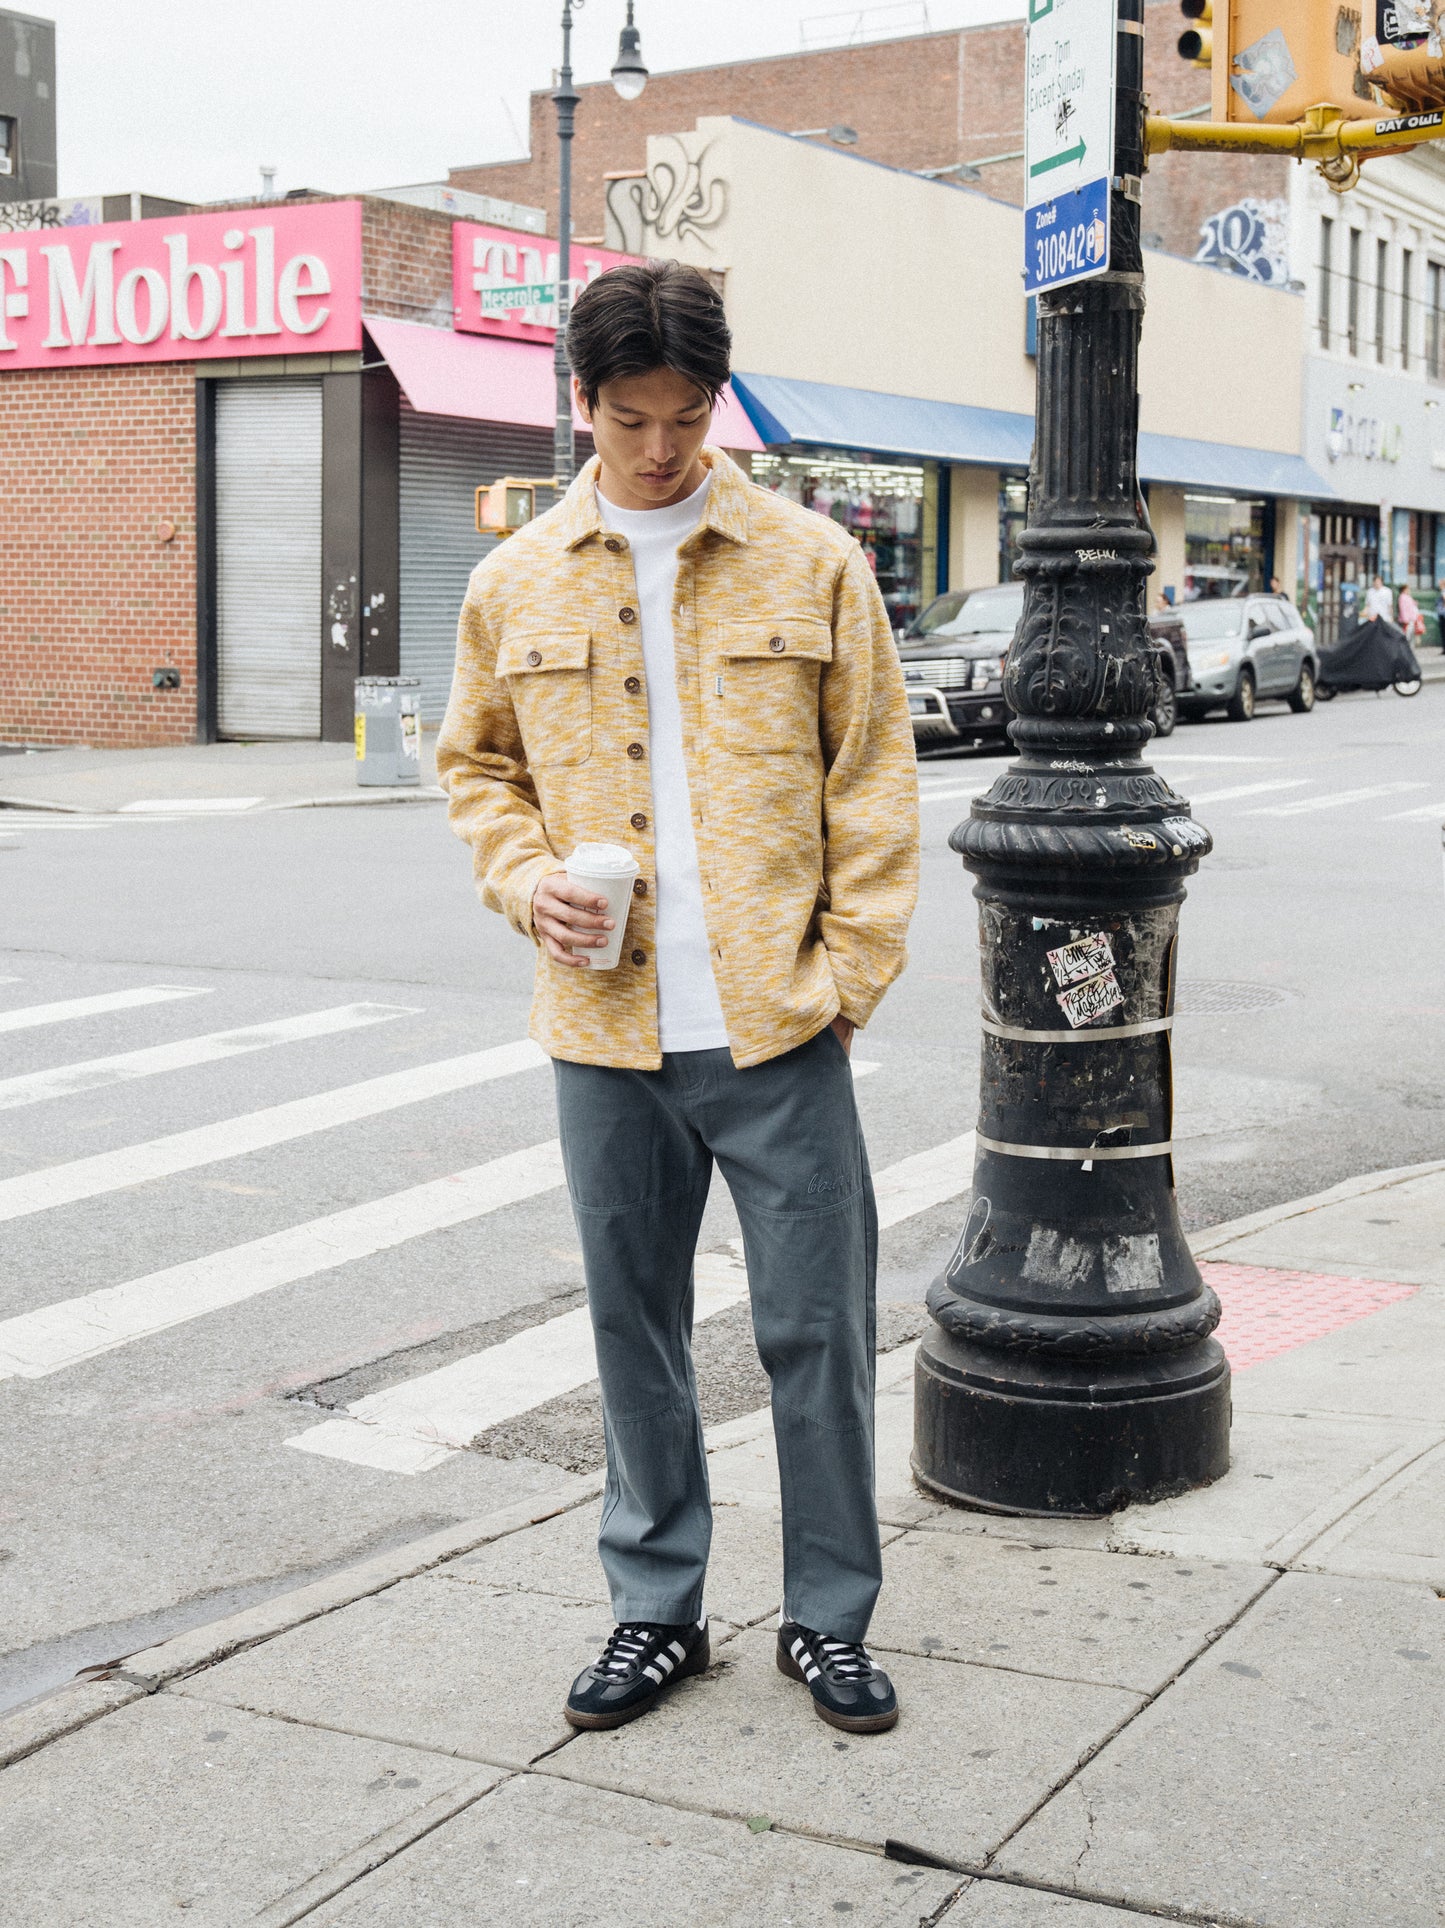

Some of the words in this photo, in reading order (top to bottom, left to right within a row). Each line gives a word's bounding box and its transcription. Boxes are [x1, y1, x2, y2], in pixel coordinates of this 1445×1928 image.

[1030, 77, 1056, 113] Except
[1057, 65, 1087, 99] Sunday
[1375, 118, 1406, 134] DAY
[1407, 113, 1442, 128] OWL
[1036, 223, 1086, 282] 310842
